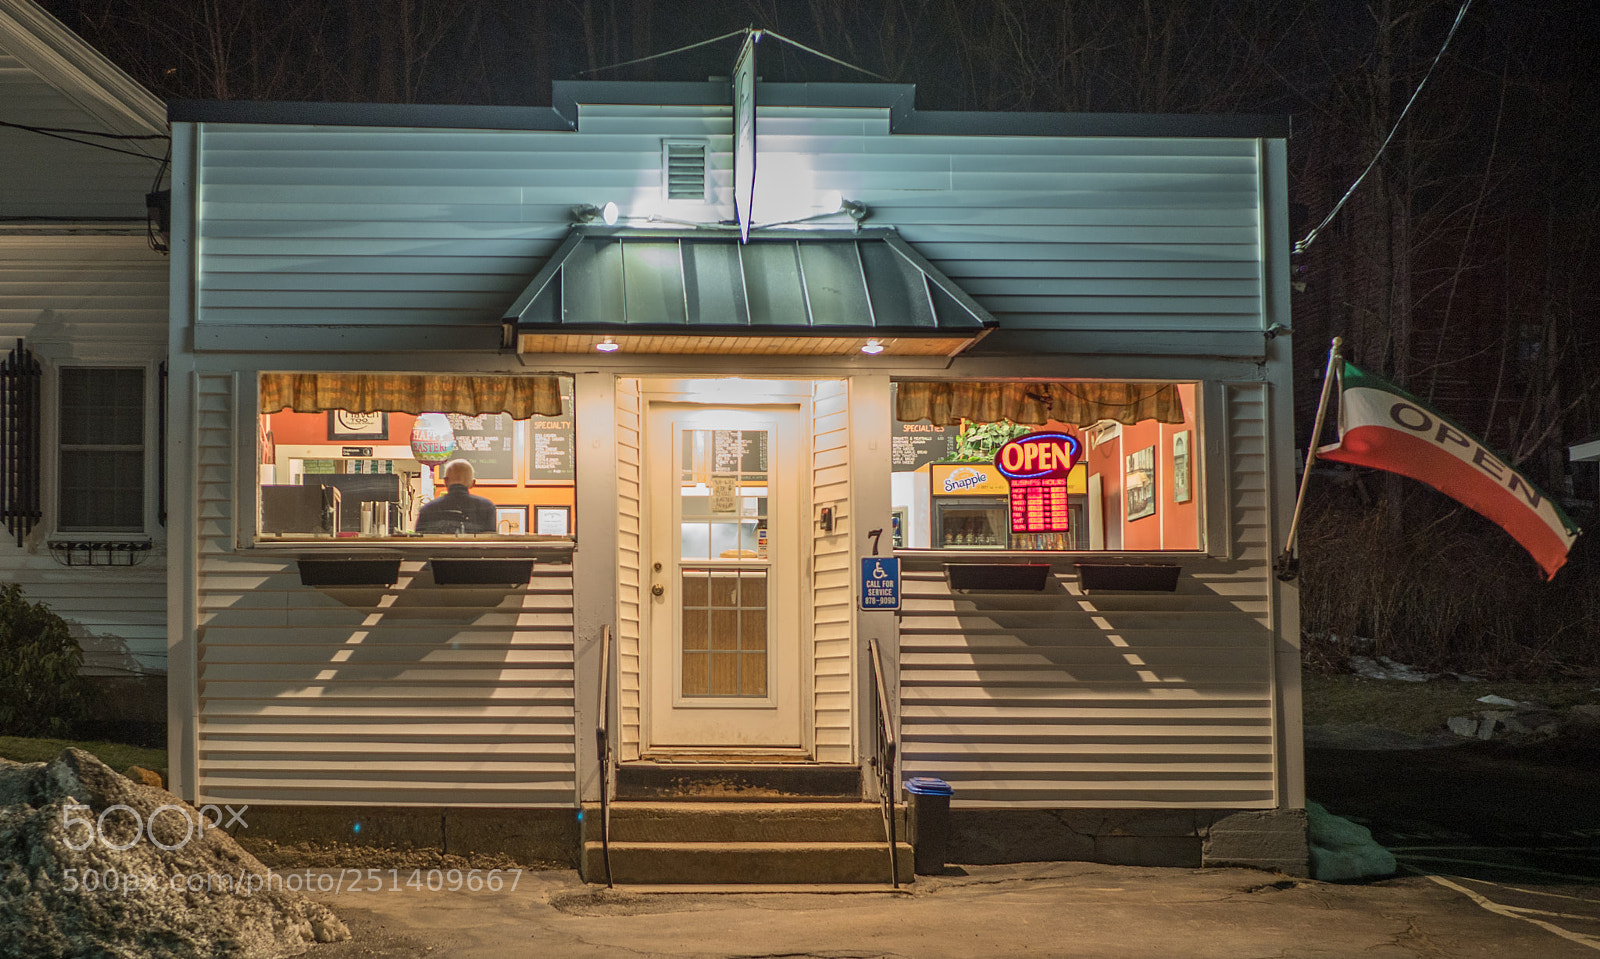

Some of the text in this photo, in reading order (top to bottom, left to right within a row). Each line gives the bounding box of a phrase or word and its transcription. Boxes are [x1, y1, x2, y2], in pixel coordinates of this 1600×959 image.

[533, 421, 572, 430] SPECIALTY
[1001, 442, 1072, 471] OPEN
[1390, 402, 1541, 509] OPEN
[944, 472, 987, 492] Snapple
[868, 528, 883, 555] 7
[866, 580, 894, 588] CALL FOR
